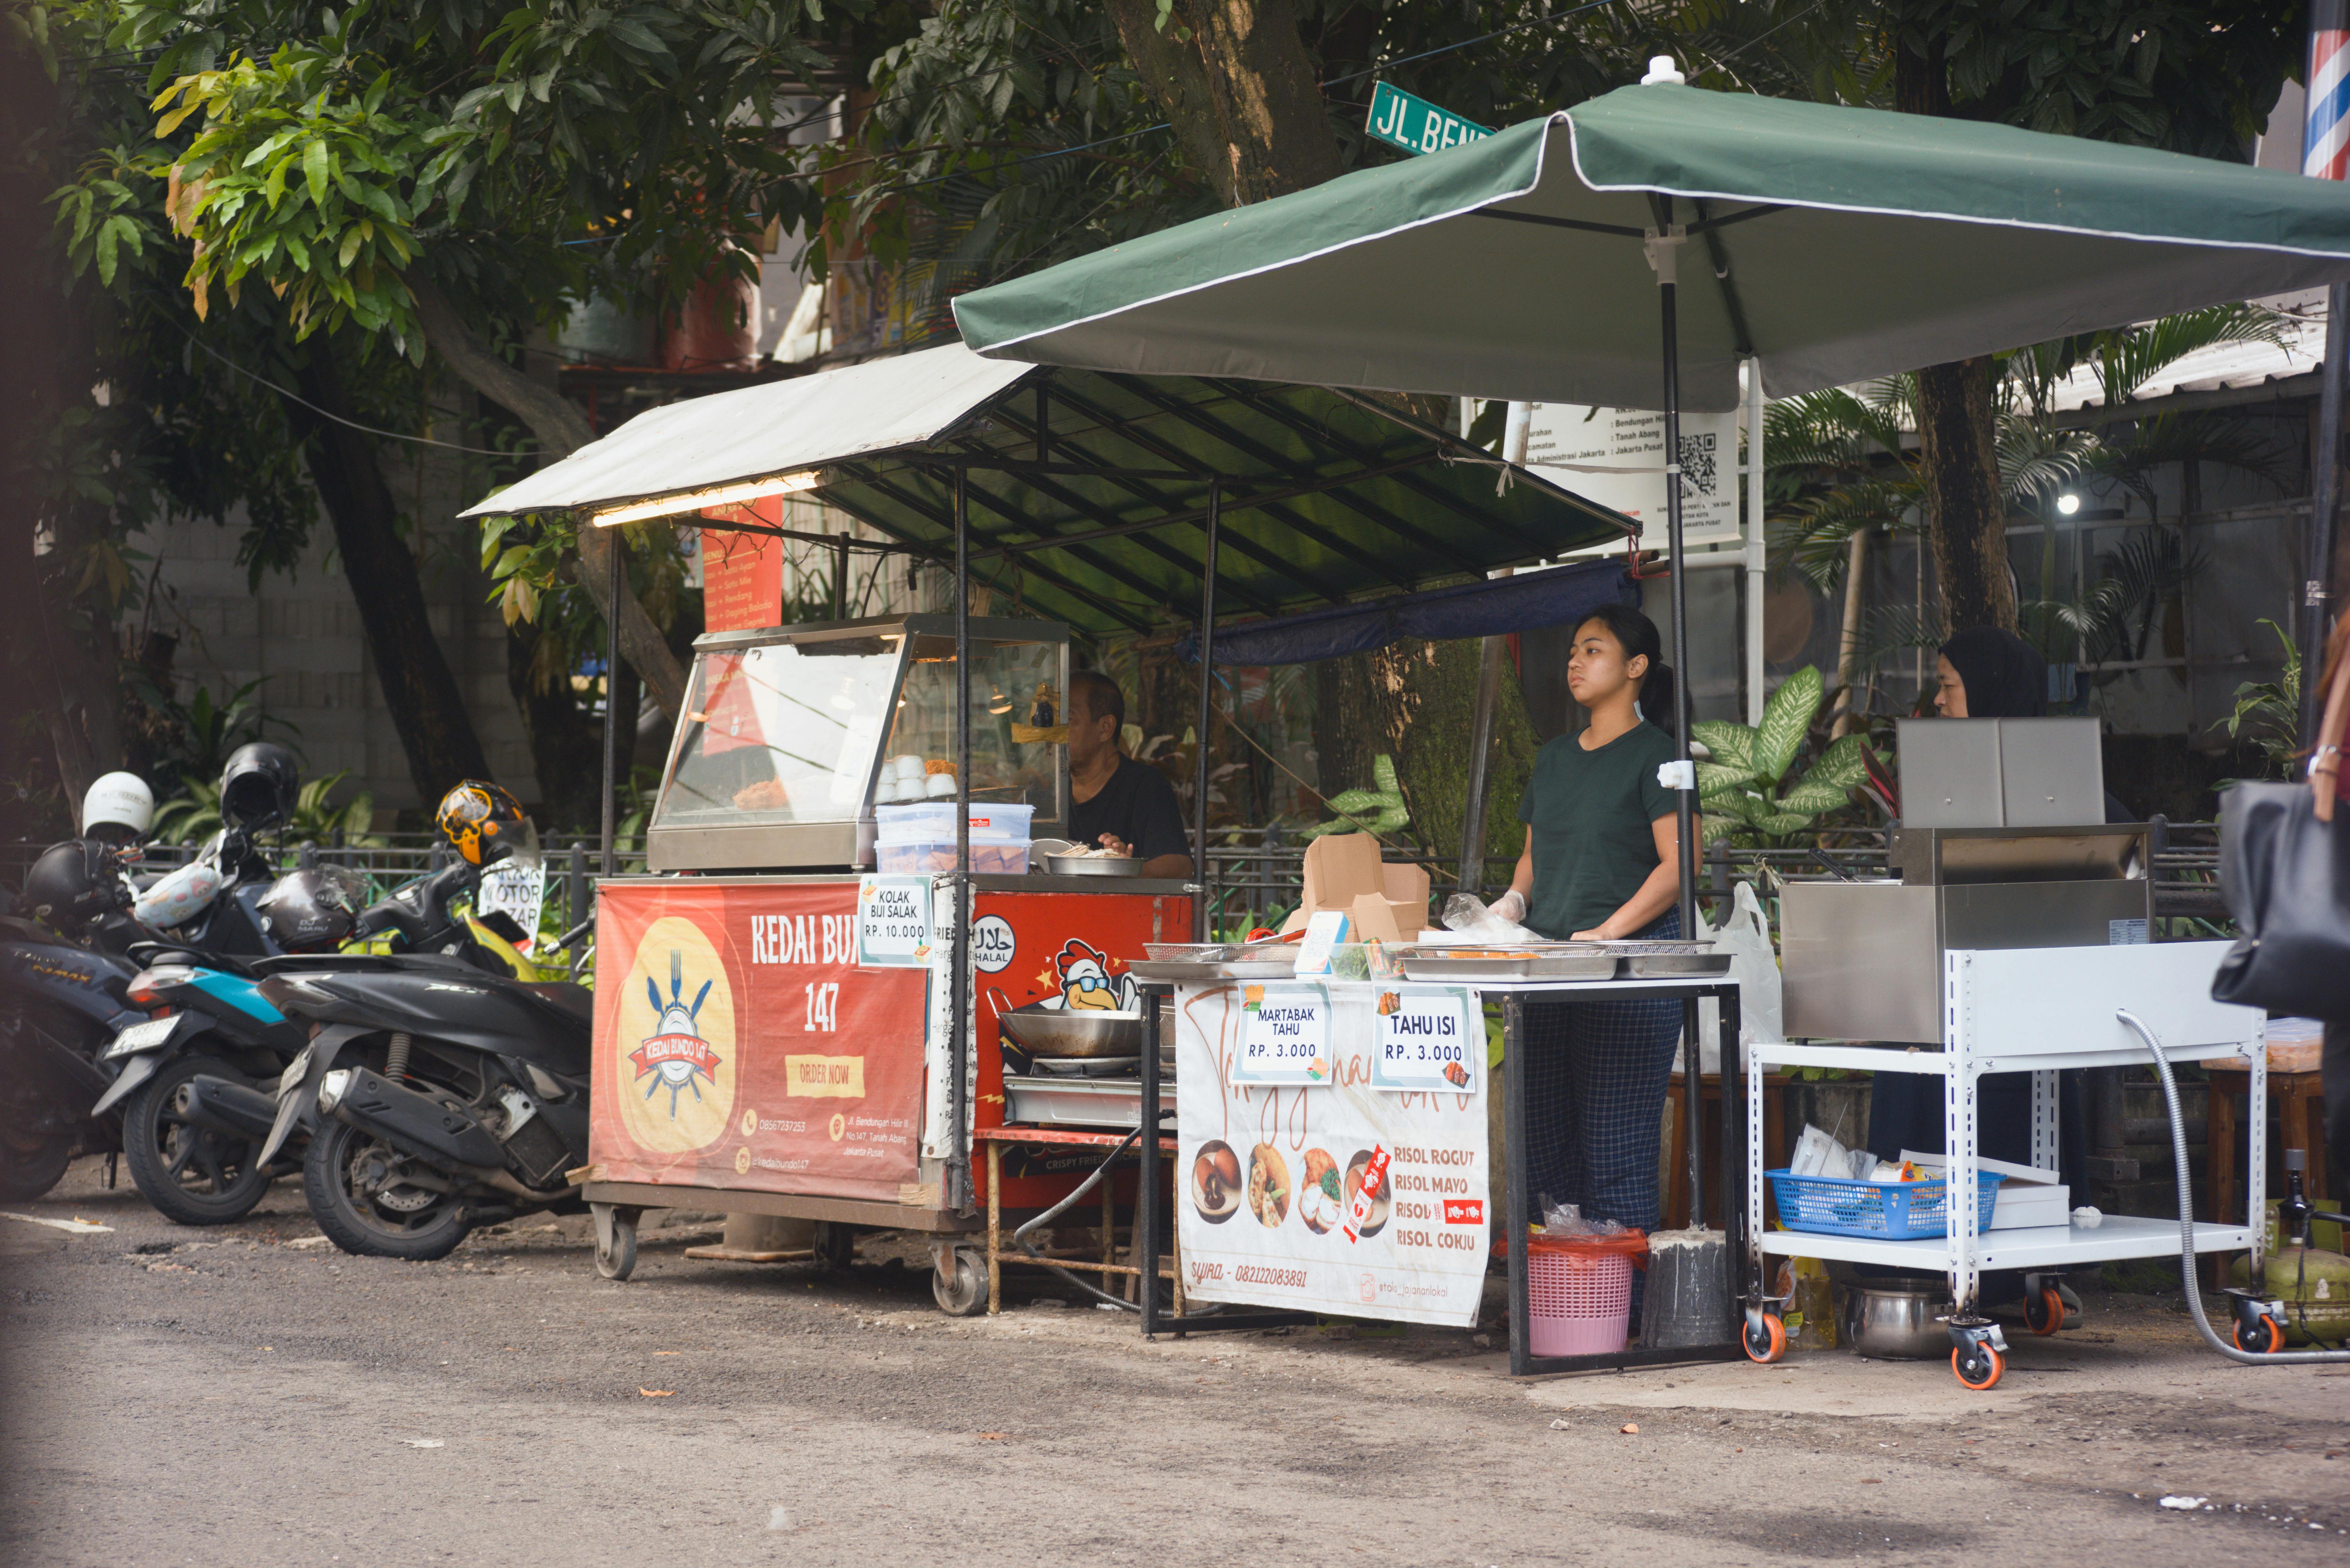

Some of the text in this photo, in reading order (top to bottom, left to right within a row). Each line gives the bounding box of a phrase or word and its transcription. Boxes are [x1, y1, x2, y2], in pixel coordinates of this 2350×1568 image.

[1529, 429, 1552, 437] urahan
[1616, 418, 1653, 427] Bendungan
[1655, 414, 1665, 423] Hil
[1527, 442, 1556, 451] camatan
[1616, 432, 1636, 441] Tanah
[1639, 430, 1660, 439] Abang
[1537, 452, 1577, 463] Administrasi
[1579, 450, 1605, 459] Jakarta
[1616, 446, 1642, 454] Jakarta
[1644, 443, 1663, 451] Pusat
[739, 562, 756, 572] Ayam
[725, 581, 738, 589] Soto
[725, 591, 752, 604] Rendang
[725, 607, 748, 619] Daging
[749, 598, 773, 612] Balado
[744, 613, 766, 629] Geprek
[879, 891, 910, 904] KOLAK
[871, 905, 917, 918] BIJI SALAK
[866, 925, 924, 938] RP. 10.000
[752, 915, 816, 964] KEDAI
[975, 953, 1008, 962] HALAL
[805, 982, 839, 1032] 147
[1258, 1008, 1315, 1021] MARTABAK
[1273, 1023, 1300, 1035] TAHU
[1391, 1015, 1455, 1035] TAHU ISI
[647, 1038, 706, 1061] KEDAI BUNDO 147
[1249, 1044, 1316, 1057] RP. 3.000
[1386, 1045, 1462, 1061] RP. 3.000
[800, 1063, 849, 1084] ORDER NOW
[759, 1120, 806, 1132] 08567237253
[856, 1117, 889, 1128] Bendungan
[891, 1118, 903, 1127] Hilir
[846, 1132, 867, 1142] No.147,
[870, 1132, 887, 1142] Tanah
[844, 1147, 884, 1157] Jakarta Pusat
[1394, 1147, 1474, 1167] RISOL ROGUT
[752, 1157, 809, 1169] @kedaibundo147
[1046, 1157, 1077, 1170] CRISPY
[1079, 1155, 1104, 1166] FRIED
[1395, 1174, 1468, 1194] RISOL MAYO
[1396, 1202, 1429, 1220] RISOL
[1397, 1229, 1474, 1250] RISOL COKJU
[1236, 1265, 1307, 1288] 082122083891
